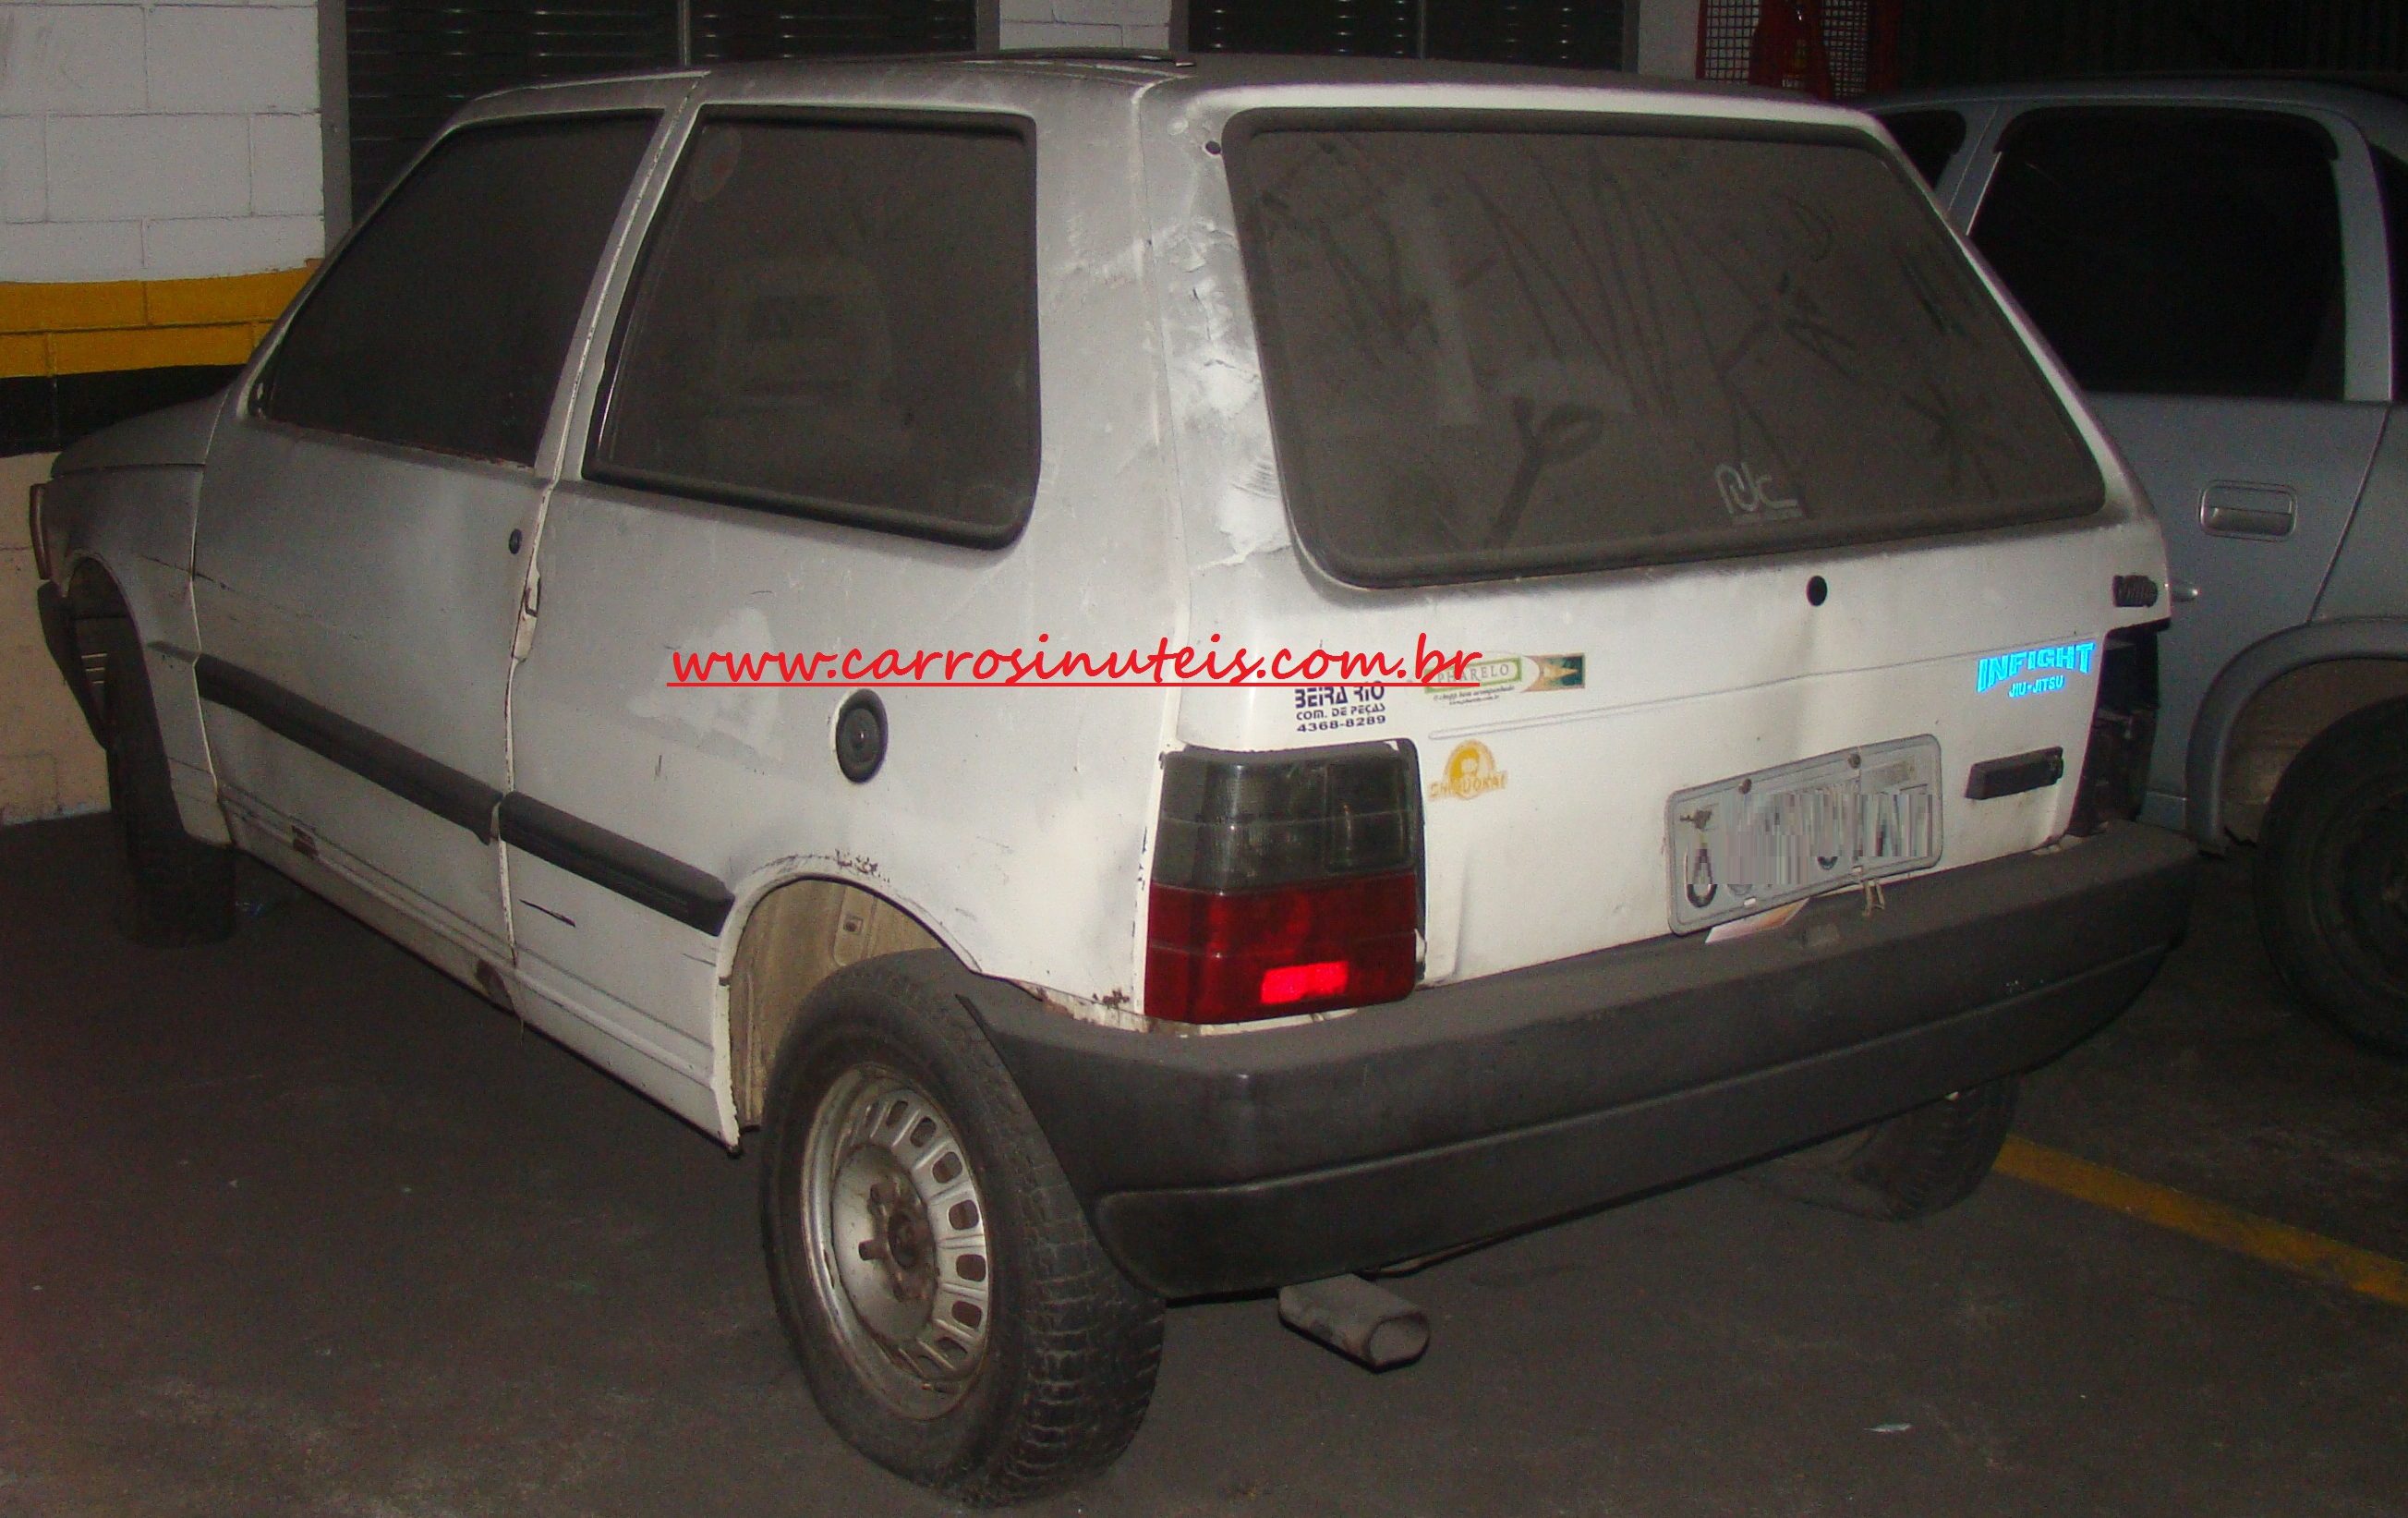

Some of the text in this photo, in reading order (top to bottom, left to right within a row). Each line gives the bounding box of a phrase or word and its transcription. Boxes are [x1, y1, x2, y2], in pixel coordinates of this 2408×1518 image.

[1977, 640, 2097, 694] INFIGHT
[1294, 680, 1385, 709] BEIRA RIO
[2008, 675, 2065, 698] JIU-JITSU
[1331, 707, 1348, 717] DE
[1296, 715, 1386, 733] 4368-8289
